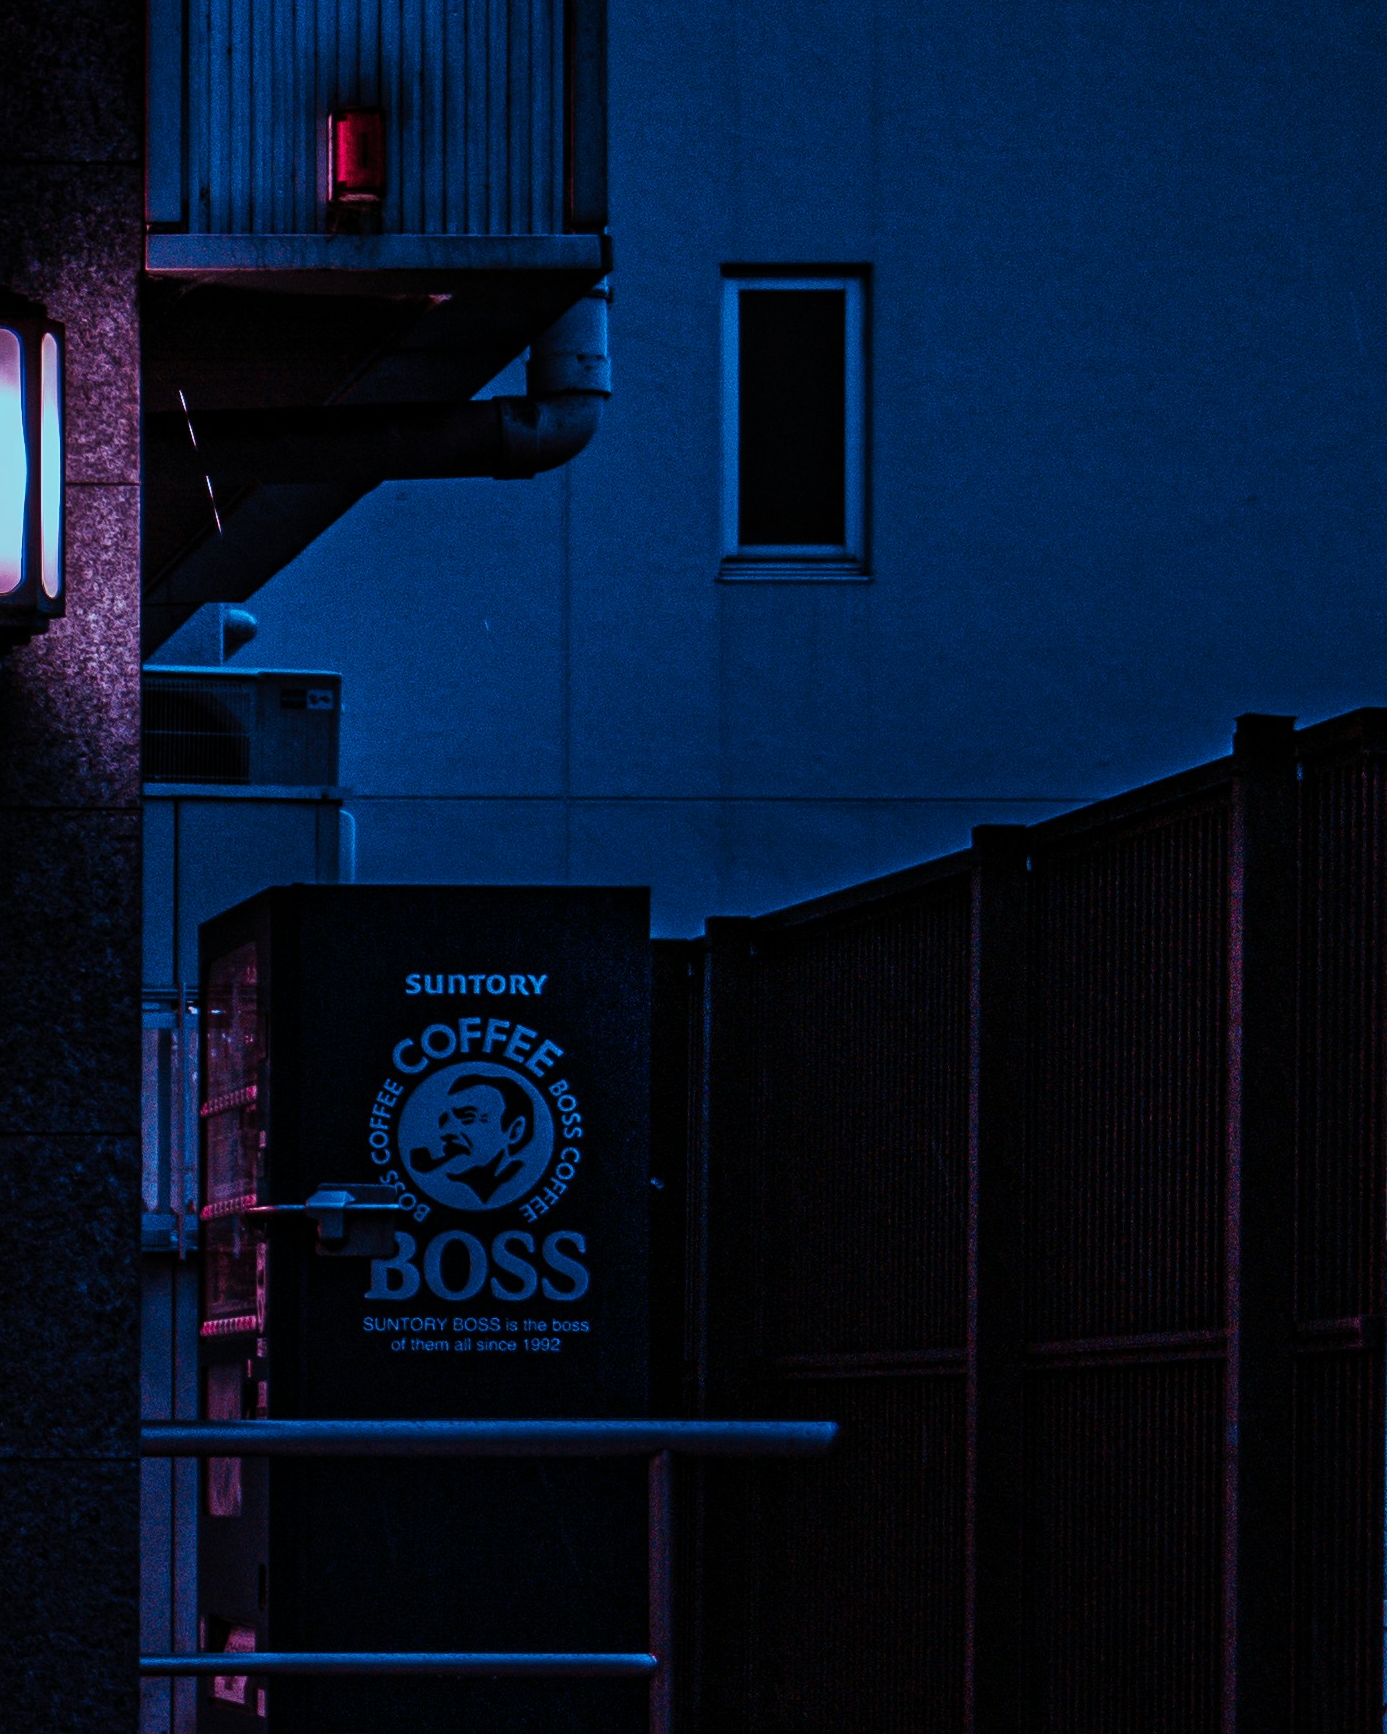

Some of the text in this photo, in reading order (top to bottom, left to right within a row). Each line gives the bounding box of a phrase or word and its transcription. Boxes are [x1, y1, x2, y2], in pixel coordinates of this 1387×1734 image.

[404, 973, 549, 996] SUNTORY
[391, 1016, 565, 1079] COFFEE
[368, 1078, 405, 1165] COFFEE
[518, 1078, 585, 1224] BOSS COFFEE
[364, 1229, 591, 1302] BOSS
[362, 1316, 590, 1332] SUNTORY BOSS is the boss
[391, 1337, 562, 1352] of them all since 1992
